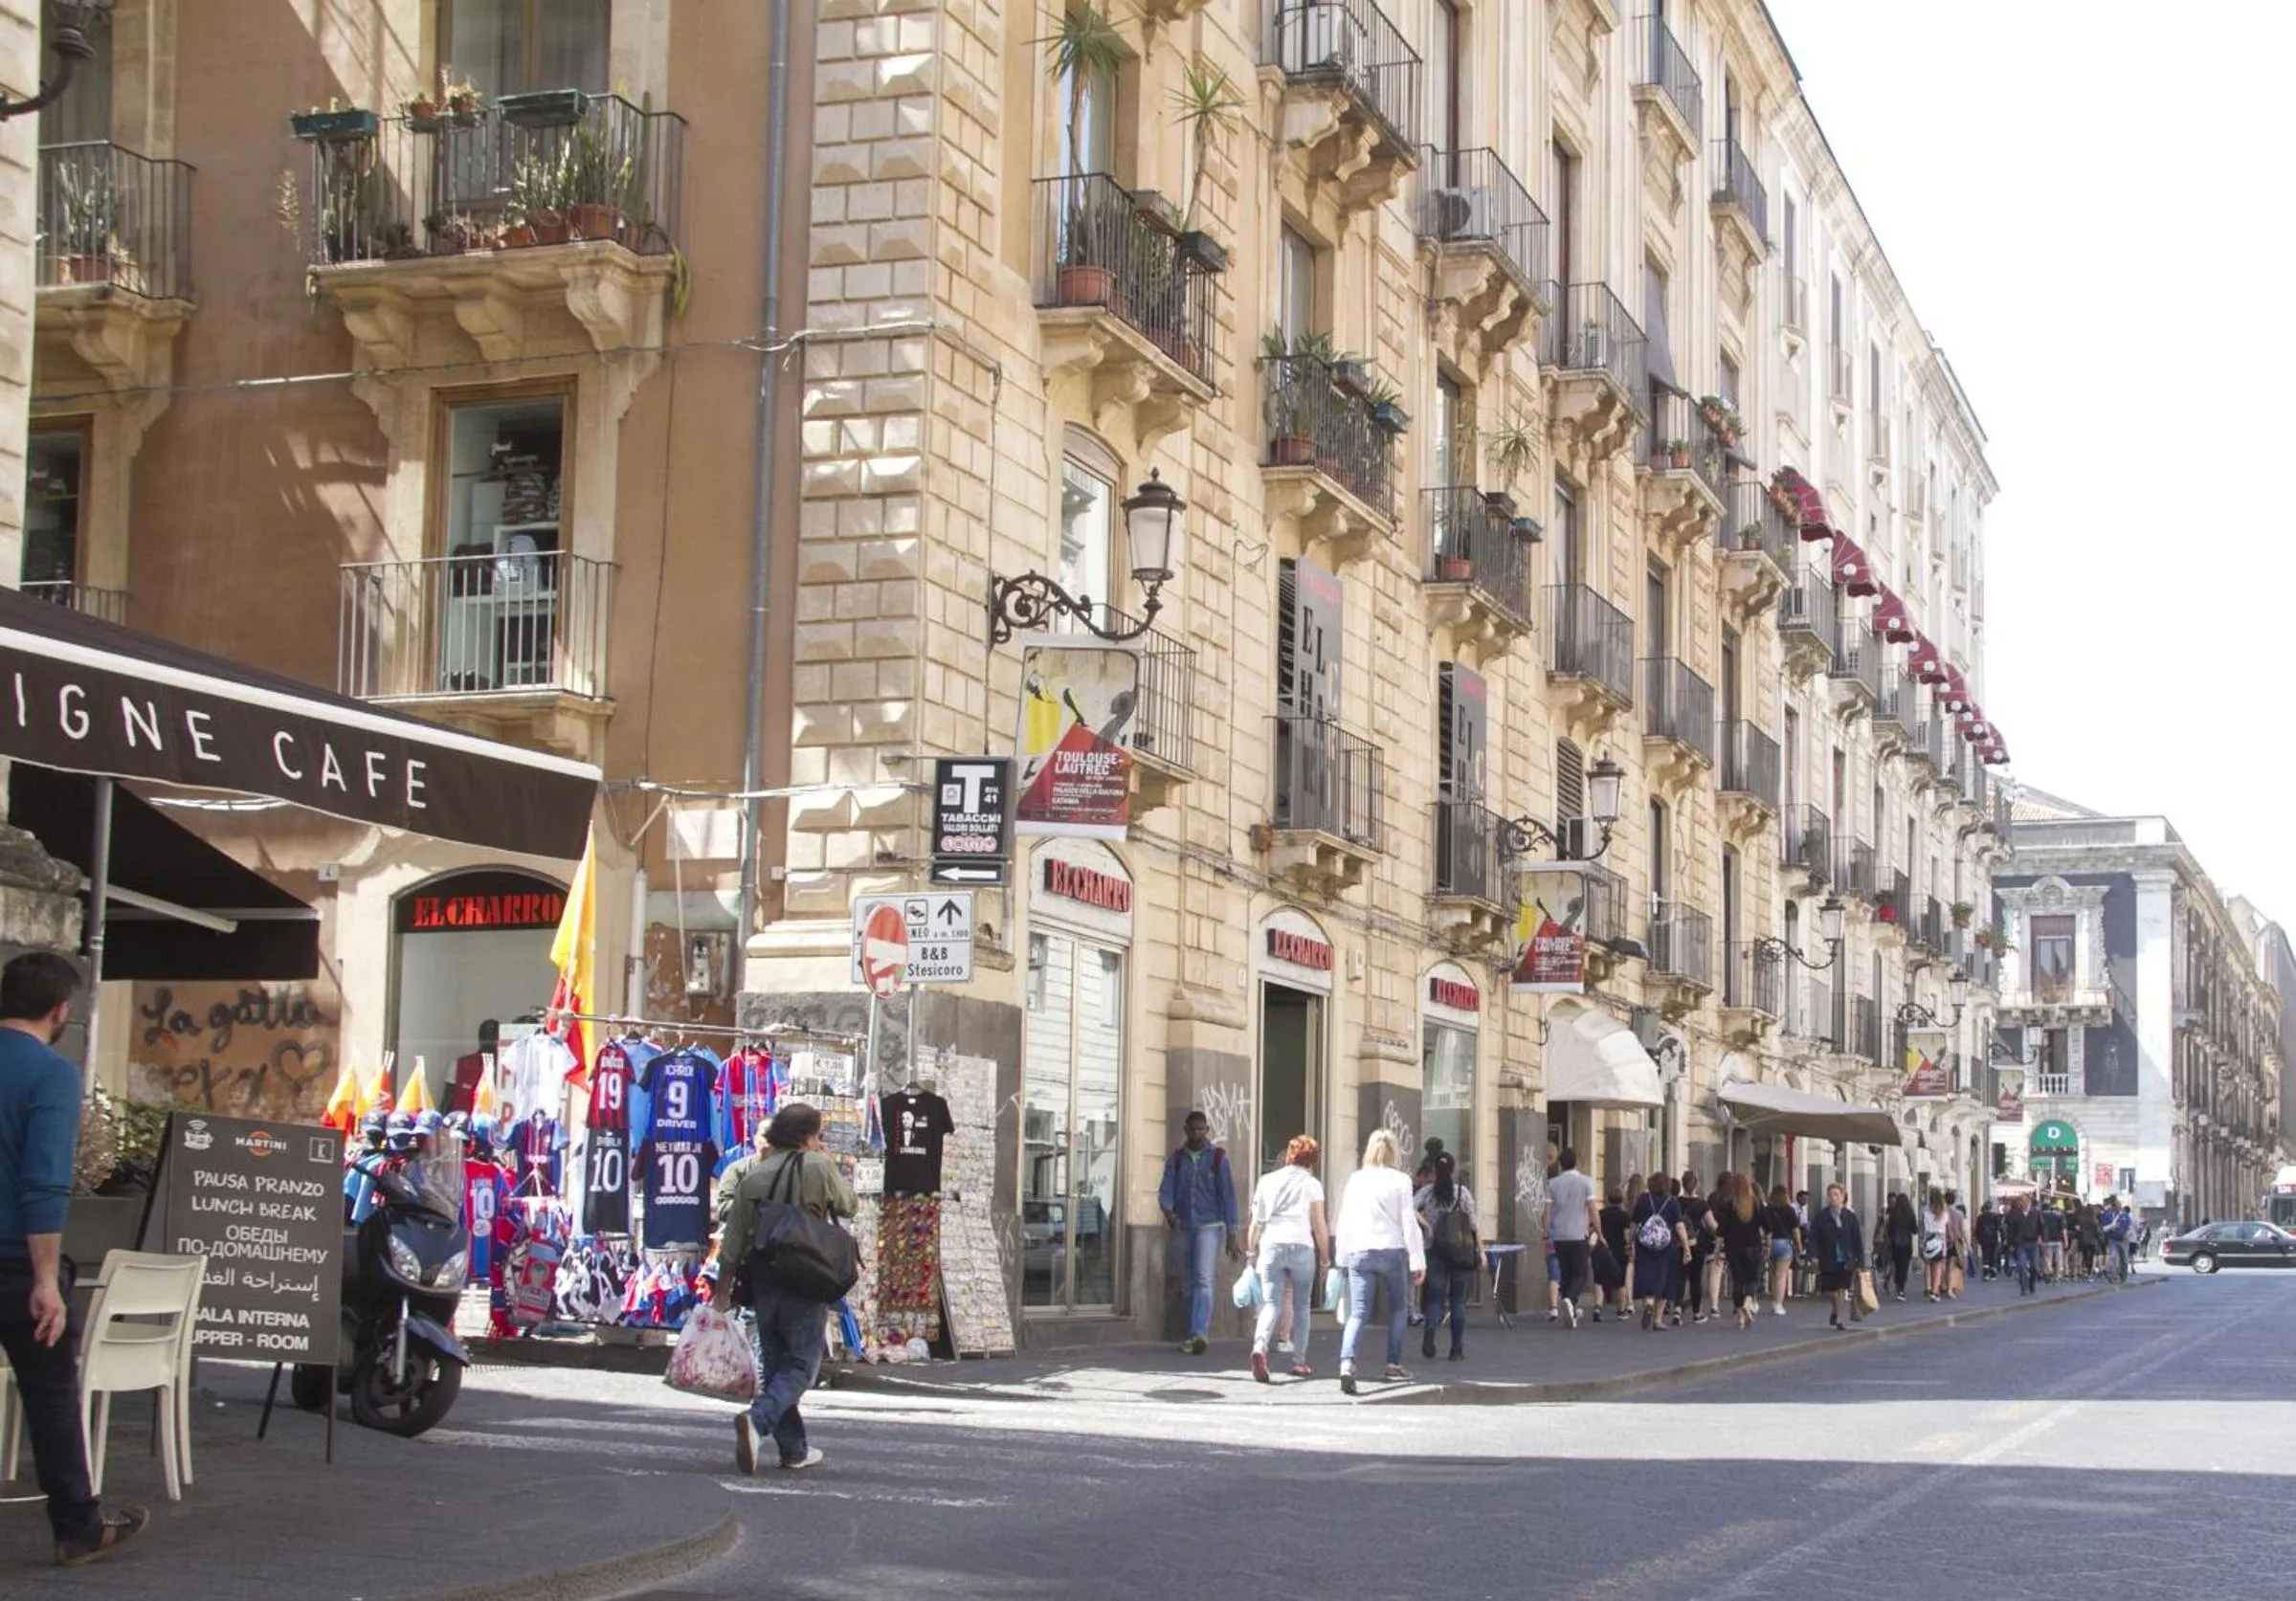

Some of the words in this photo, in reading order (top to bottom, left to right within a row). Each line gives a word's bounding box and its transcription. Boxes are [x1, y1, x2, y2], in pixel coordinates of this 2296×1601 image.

[274, 731, 427, 809] CAFE
[1055, 762, 1109, 775] LAUTREC
[952, 765, 995, 813] T
[941, 812, 1002, 823] TABACCHI
[921, 946, 948, 961] B&B
[907, 963, 964, 977] Stesicoro
[598, 1071, 623, 1110] 19
[666, 1079, 689, 1120] 9
[657, 1118, 698, 1129] DRIVER
[2047, 1126, 2061, 1139] D
[235, 1136, 287, 1151] MARTINI
[589, 1147, 623, 1193] 10
[657, 1153, 700, 1194] 10
[194, 1169, 249, 1190] PAUSA
[255, 1176, 325, 1197] PRANZO
[191, 1194, 254, 1216] LUNCH
[259, 1202, 318, 1222] BREAK
[226, 1225, 288, 1244] ОБЕДЫ
[177, 1237, 329, 1265] ПО-ДОМАШНЕМУ
[238, 1309, 310, 1328] INTERNA
[256, 1334, 309, 1351] ROOM
